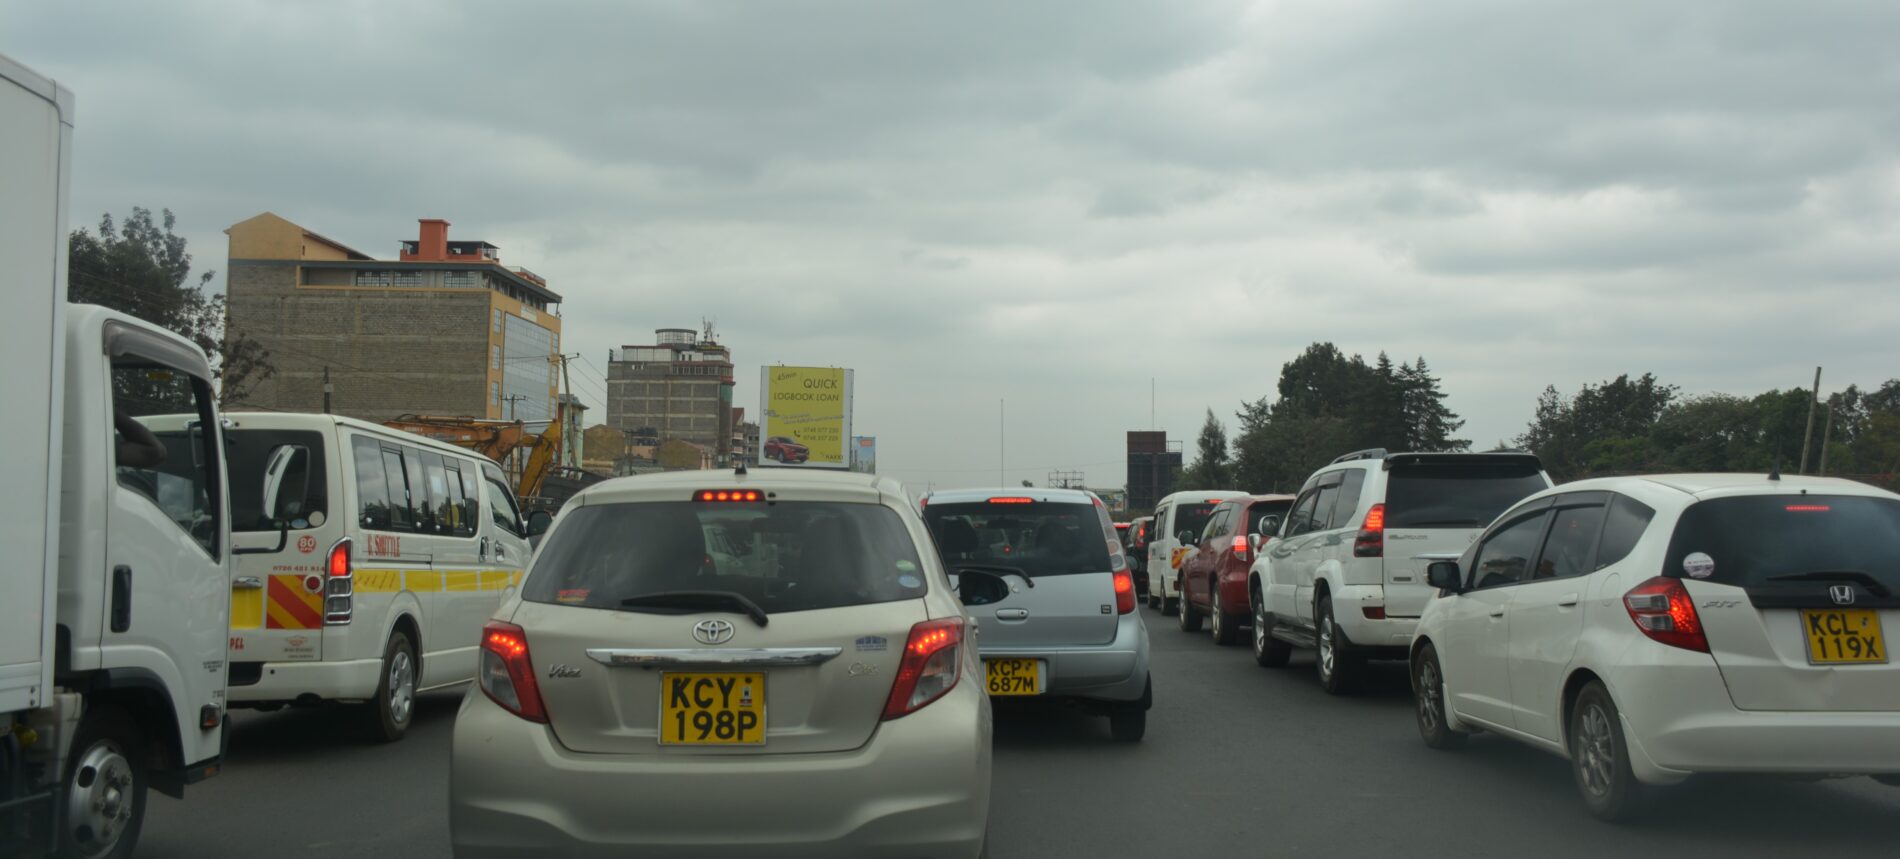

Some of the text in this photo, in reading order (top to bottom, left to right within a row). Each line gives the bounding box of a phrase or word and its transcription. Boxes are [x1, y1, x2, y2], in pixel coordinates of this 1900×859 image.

[803, 378, 838, 390] QUICK
[773, 392, 840, 402] LOGBOOK LOAN
[300, 537, 314, 547] 80
[1808, 612, 1860, 636] KCL
[1817, 636, 1880, 660] 119X
[988, 660, 1022, 677] KCP
[989, 676, 1035, 692] 687M
[670, 677, 735, 709] KCY
[676, 710, 758, 741] 198P
